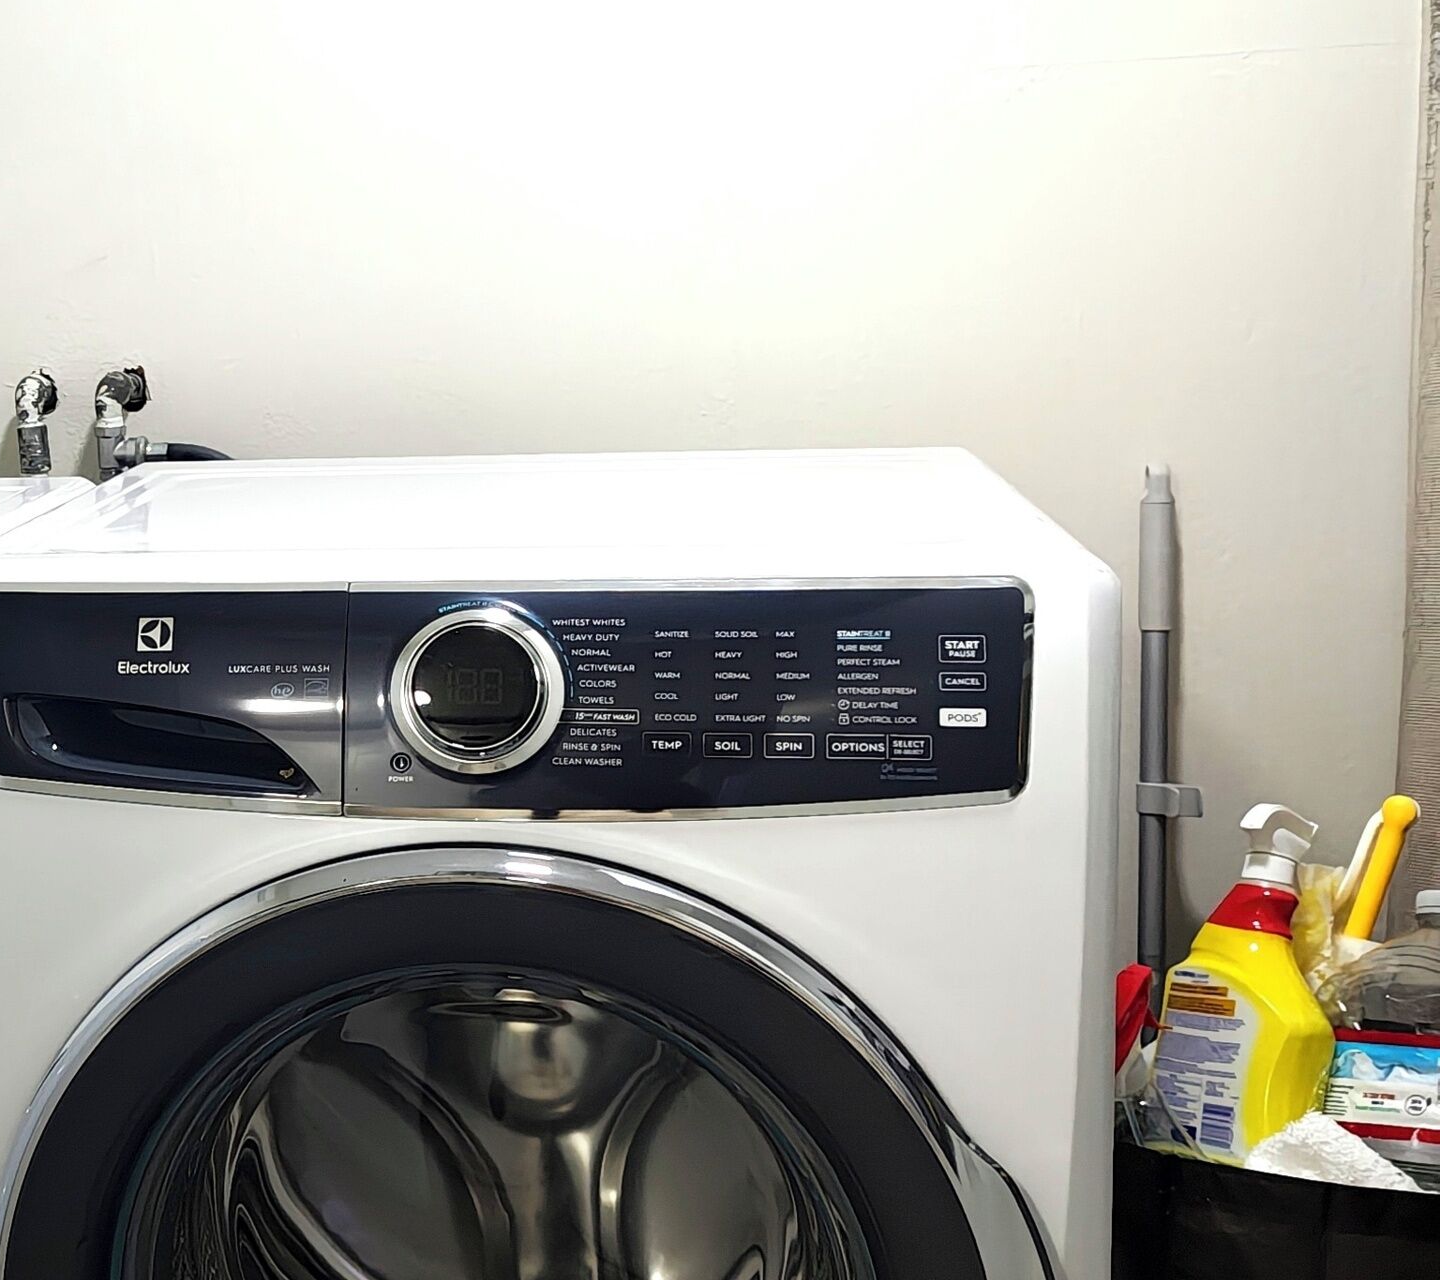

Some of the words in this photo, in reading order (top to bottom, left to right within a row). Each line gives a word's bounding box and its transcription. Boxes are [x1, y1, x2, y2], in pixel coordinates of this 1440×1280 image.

[945, 640, 980, 649] START
[571, 649, 611, 657] NORMAL
[949, 650, 976, 658] PAUSE
[117, 661, 190, 674] Electrolux
[228, 665, 272, 673] LUXCARE
[275, 665, 298, 673] PLUS
[302, 665, 330, 673] WASH
[577, 664, 635, 672] ACTIVEWEAR
[579, 680, 617, 688] COLORS
[837, 687, 881, 695] EXTENDED
[578, 696, 614, 704] TOWELS
[715, 693, 739, 701] LIGHT
[655, 714, 672, 722] ECO
[673, 714, 697, 722] COLD
[792, 715, 811, 723] SPIN
[947, 713, 979, 723] PODS
[570, 728, 617, 737] DELICATES
[563, 743, 589, 751] RINSE
[600, 743, 621, 751] SPIN
[652, 740, 683, 750] TEMP
[714, 741, 741, 751] SOIL
[775, 742, 803, 751] SPIN
[831, 742, 885, 752] OPTIONS
[892, 740, 925, 748] SELECT
[552, 757, 582, 765] CLEAN
[584, 758, 622, 766] WASHER
